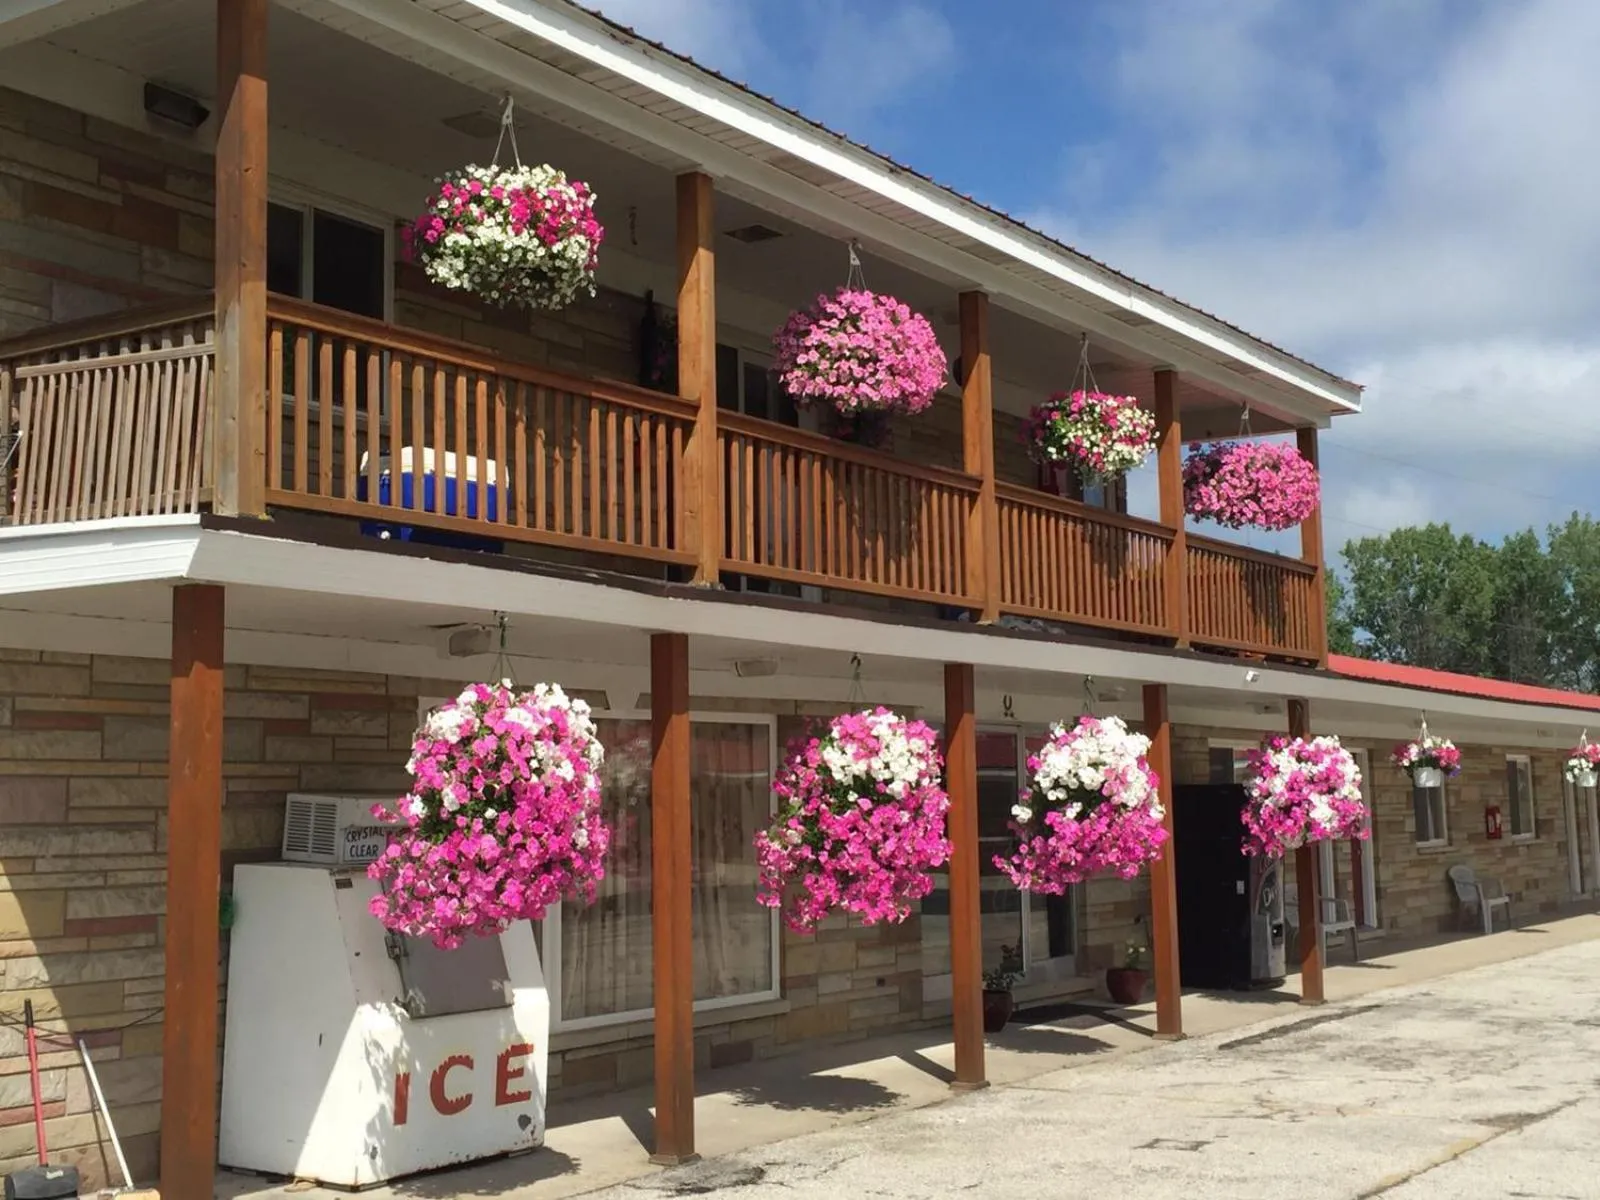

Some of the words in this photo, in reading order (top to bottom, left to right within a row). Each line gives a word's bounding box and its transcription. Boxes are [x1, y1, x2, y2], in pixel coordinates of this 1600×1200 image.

[346, 826, 384, 842] CRYSTAL
[349, 844, 379, 857] CLEAR
[393, 1043, 534, 1126] ICE
